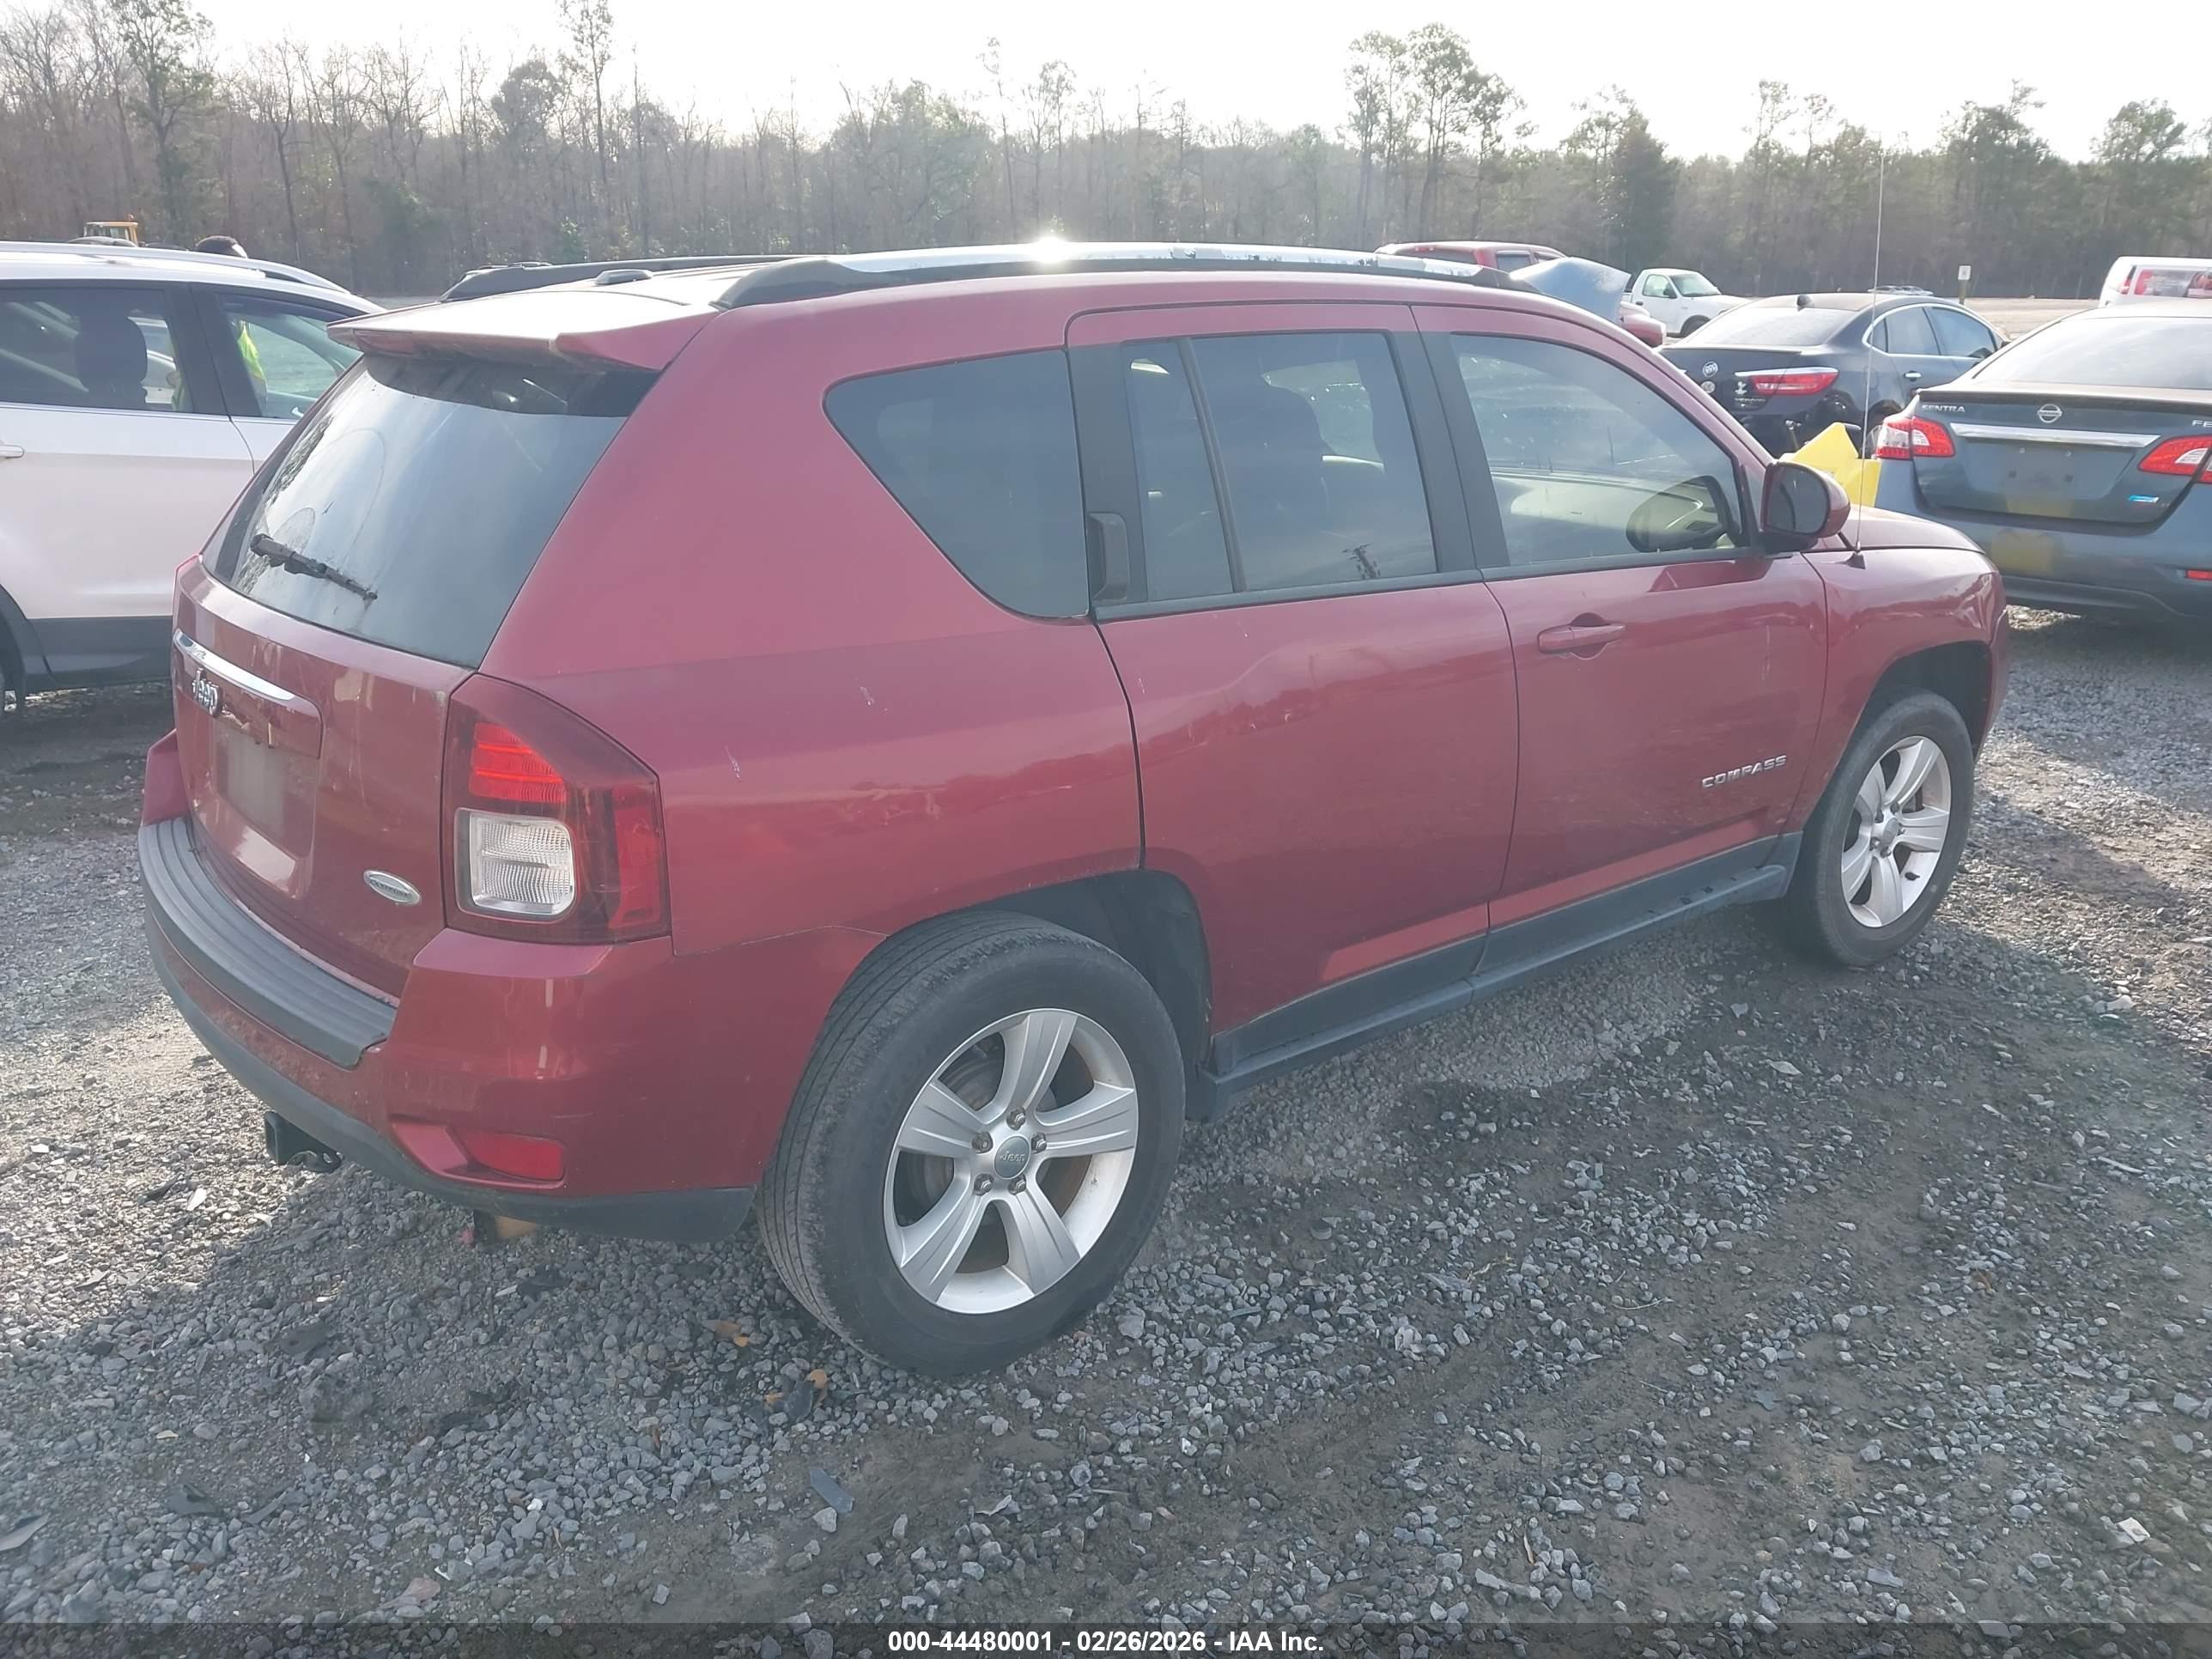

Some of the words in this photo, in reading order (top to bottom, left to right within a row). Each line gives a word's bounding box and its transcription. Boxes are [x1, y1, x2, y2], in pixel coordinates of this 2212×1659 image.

[1922, 404, 1966, 413] SENTRA
[191, 667, 222, 716] Jeep
[1702, 755, 1787, 788] COMPASS
[1000, 1151, 1026, 1164] Jeep
